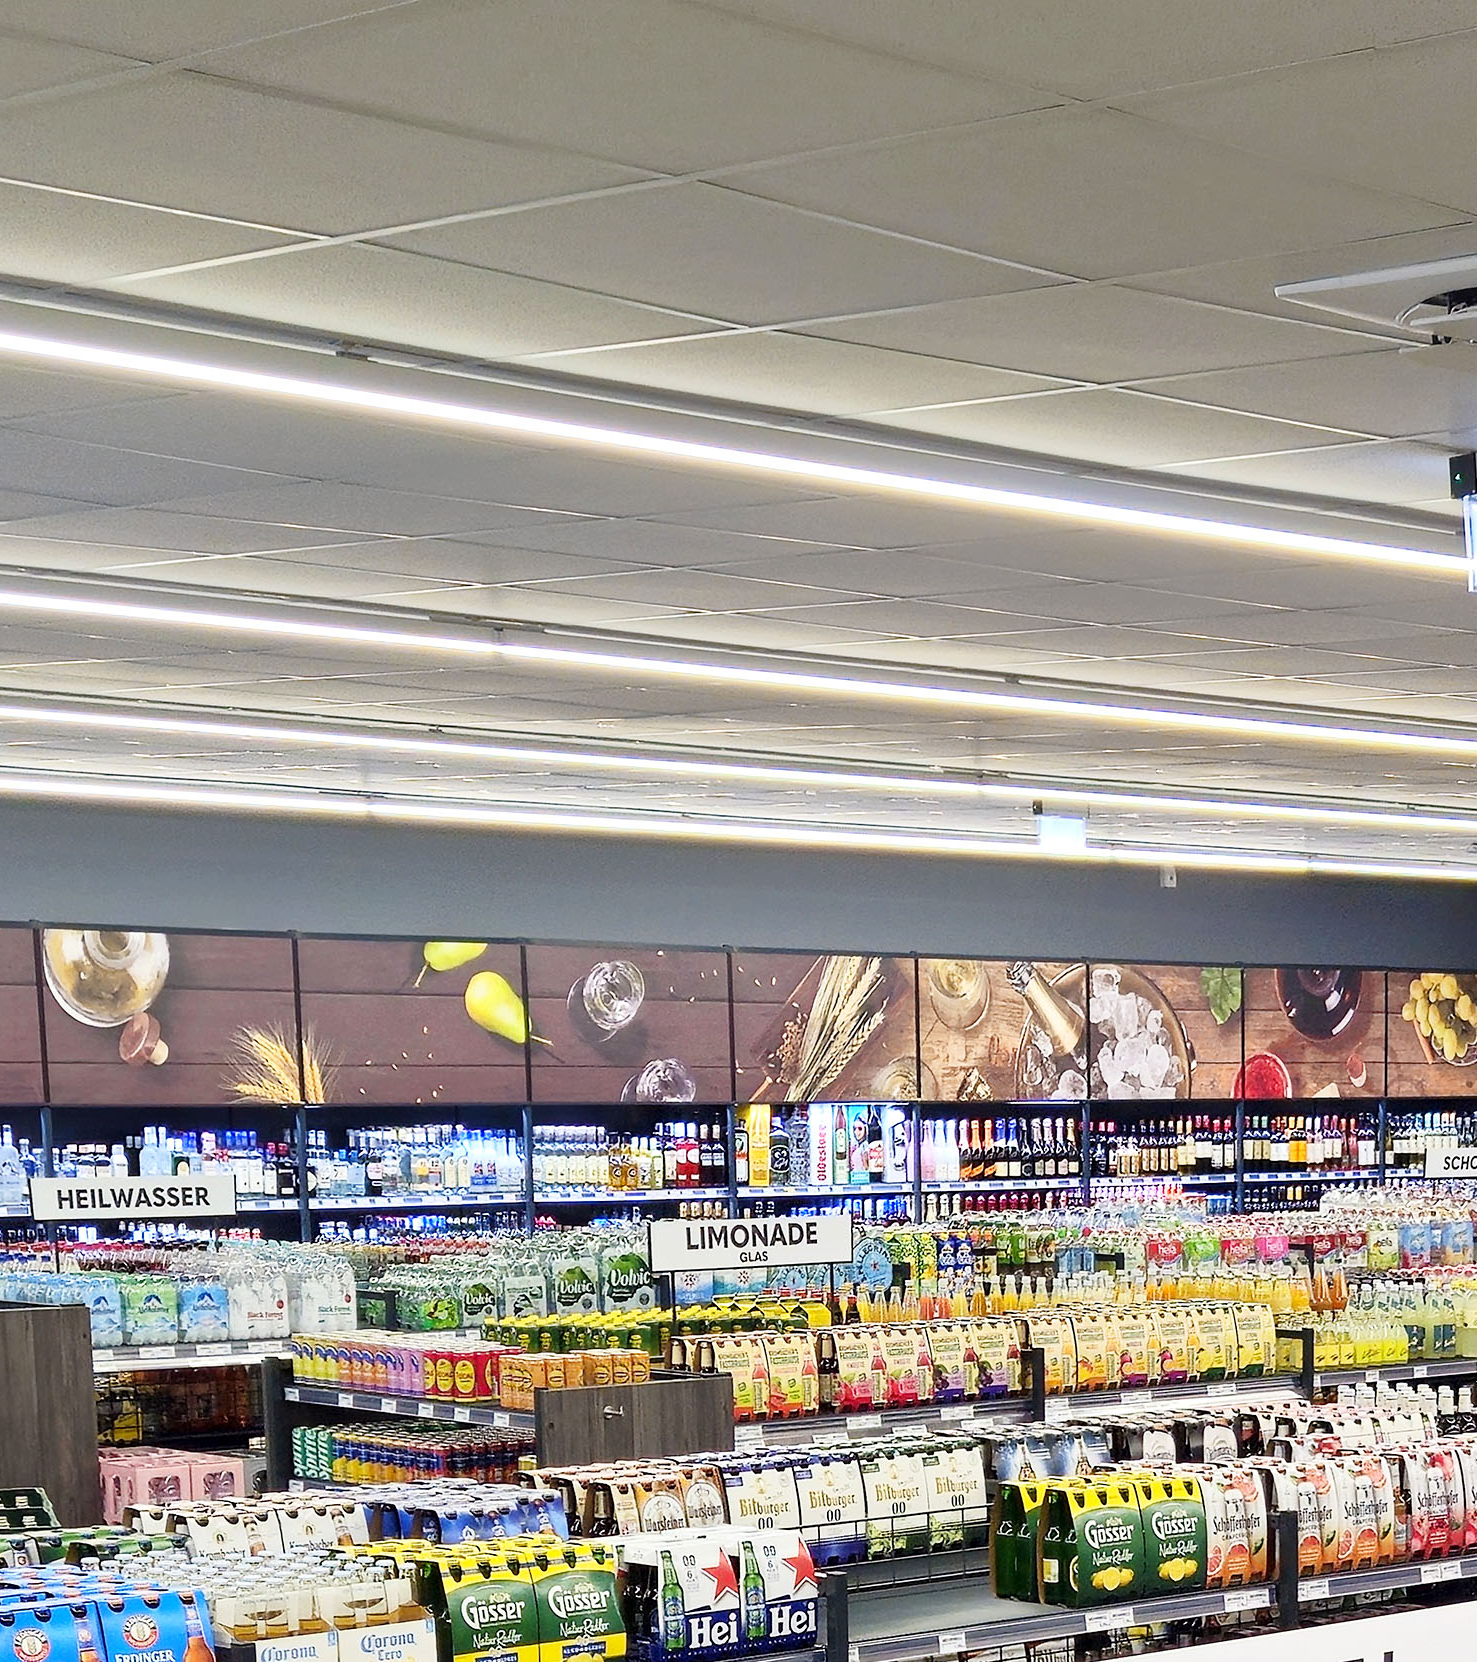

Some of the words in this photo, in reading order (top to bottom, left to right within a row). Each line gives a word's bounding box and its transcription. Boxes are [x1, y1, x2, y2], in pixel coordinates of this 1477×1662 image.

[57, 1187, 211, 1209] HEILWASSER
[686, 1221, 818, 1250] LIMONADE
[739, 1251, 769, 1263] GLAS
[558, 1280, 594, 1296] Volvic
[610, 1268, 651, 1289] Volvic
[875, 1482, 921, 1503] Bitburger
[935, 1476, 979, 1495] Bitburger
[739, 1498, 791, 1519] Bitburger
[810, 1491, 858, 1510] Bitburger
[1084, 1518, 1135, 1545] Gösser
[1152, 1511, 1199, 1538] Gösser
[462, 1598, 526, 1629] Gösser
[548, 1588, 611, 1618] Gösser
[360, 1632, 417, 1654] Corona
